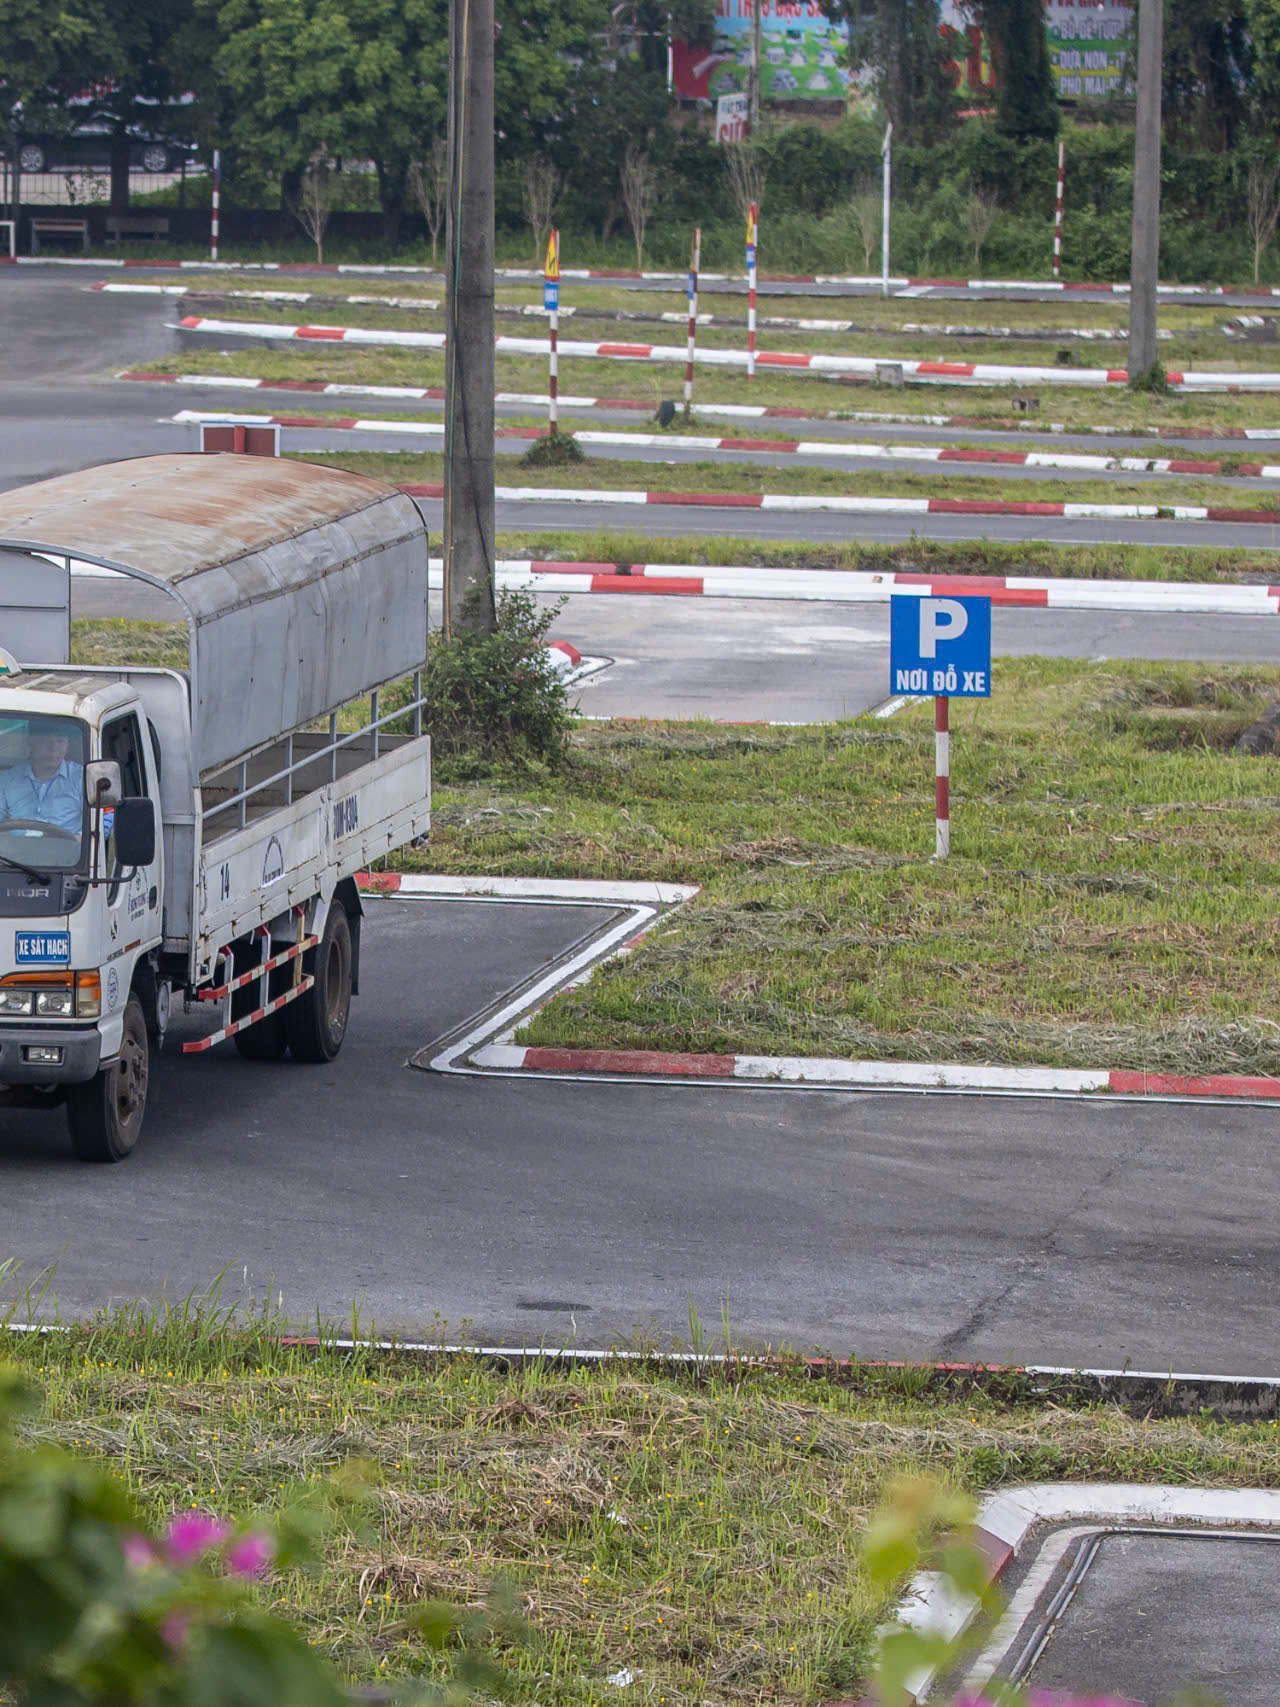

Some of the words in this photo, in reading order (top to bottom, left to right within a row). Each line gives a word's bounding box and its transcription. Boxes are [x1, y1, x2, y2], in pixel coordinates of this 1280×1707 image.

[919, 598, 968, 659] P
[896, 668, 928, 691] NƠI
[933, 664, 957, 692] ĐỖ
[962, 671, 986, 693] XE
[220, 862, 231, 901] 14
[18, 939, 29, 956] XE
[30, 935, 46, 956] SÁT
[47, 938, 68, 959] HẠCH
